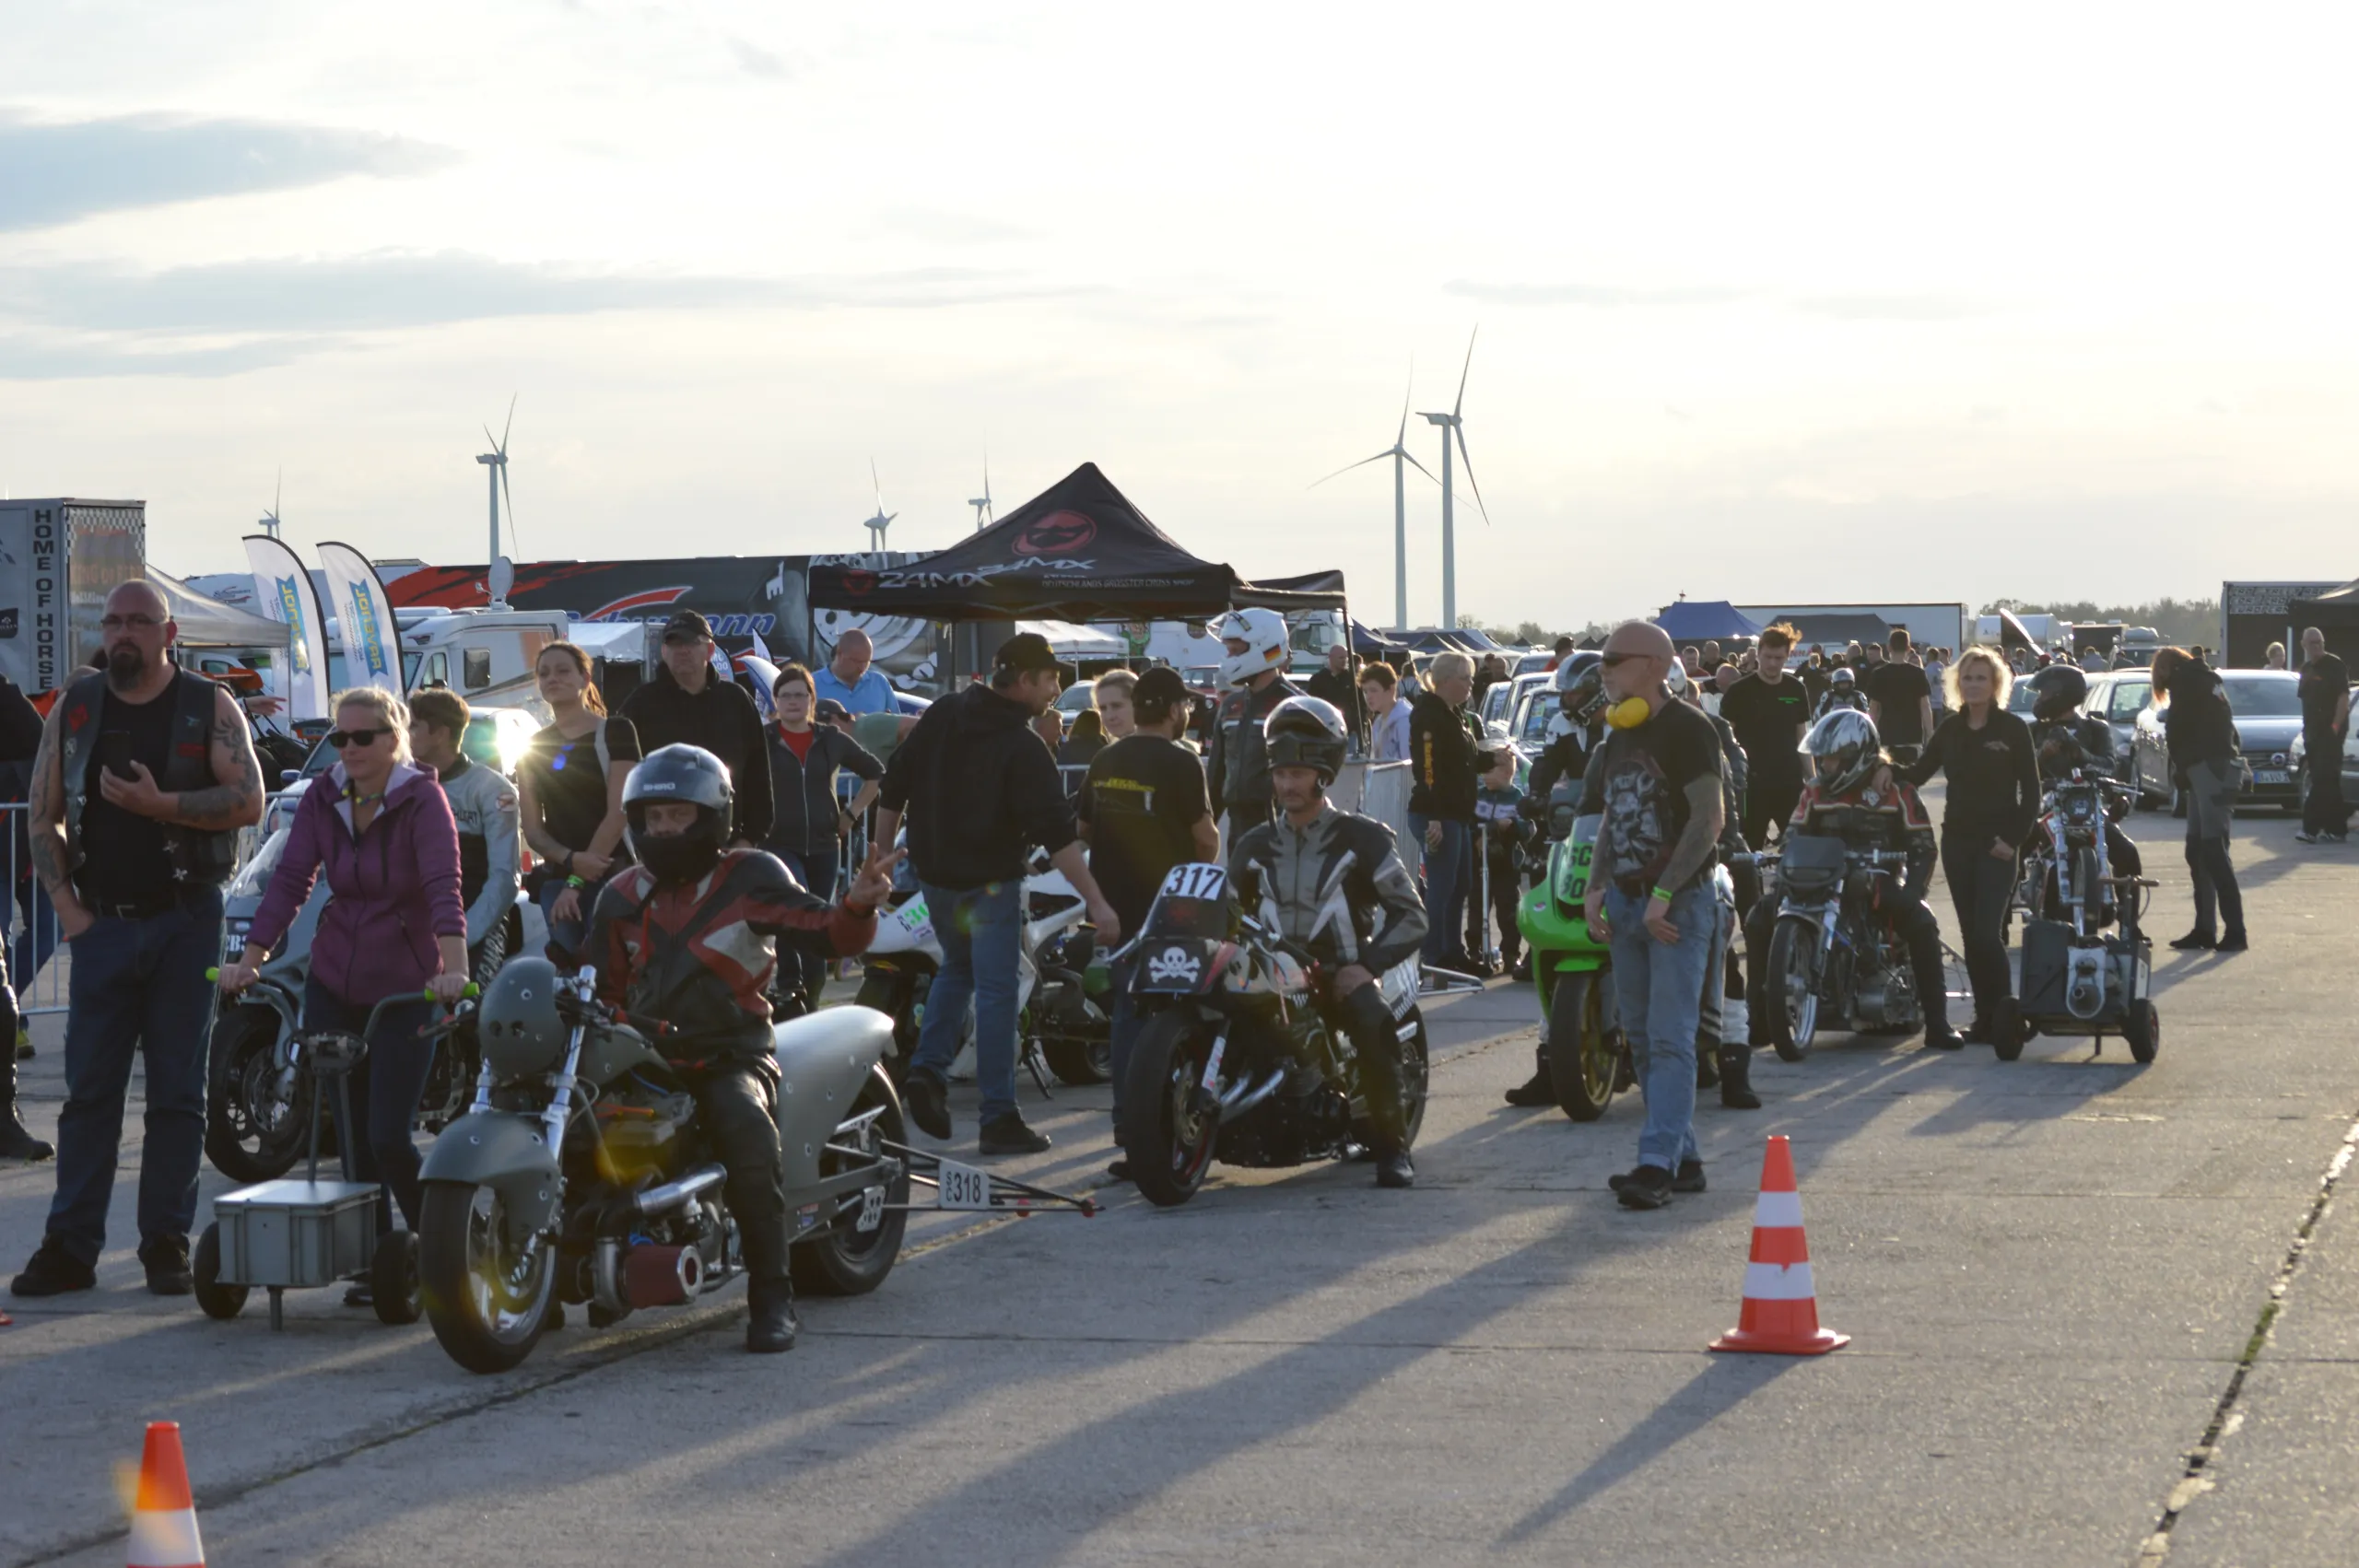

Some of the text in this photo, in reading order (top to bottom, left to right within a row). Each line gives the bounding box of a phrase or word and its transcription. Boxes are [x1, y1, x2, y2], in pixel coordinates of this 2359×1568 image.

[33, 509, 54, 690] HOME OF HORSE
[1165, 866, 1225, 897] 317
[954, 1172, 981, 1204] 318
